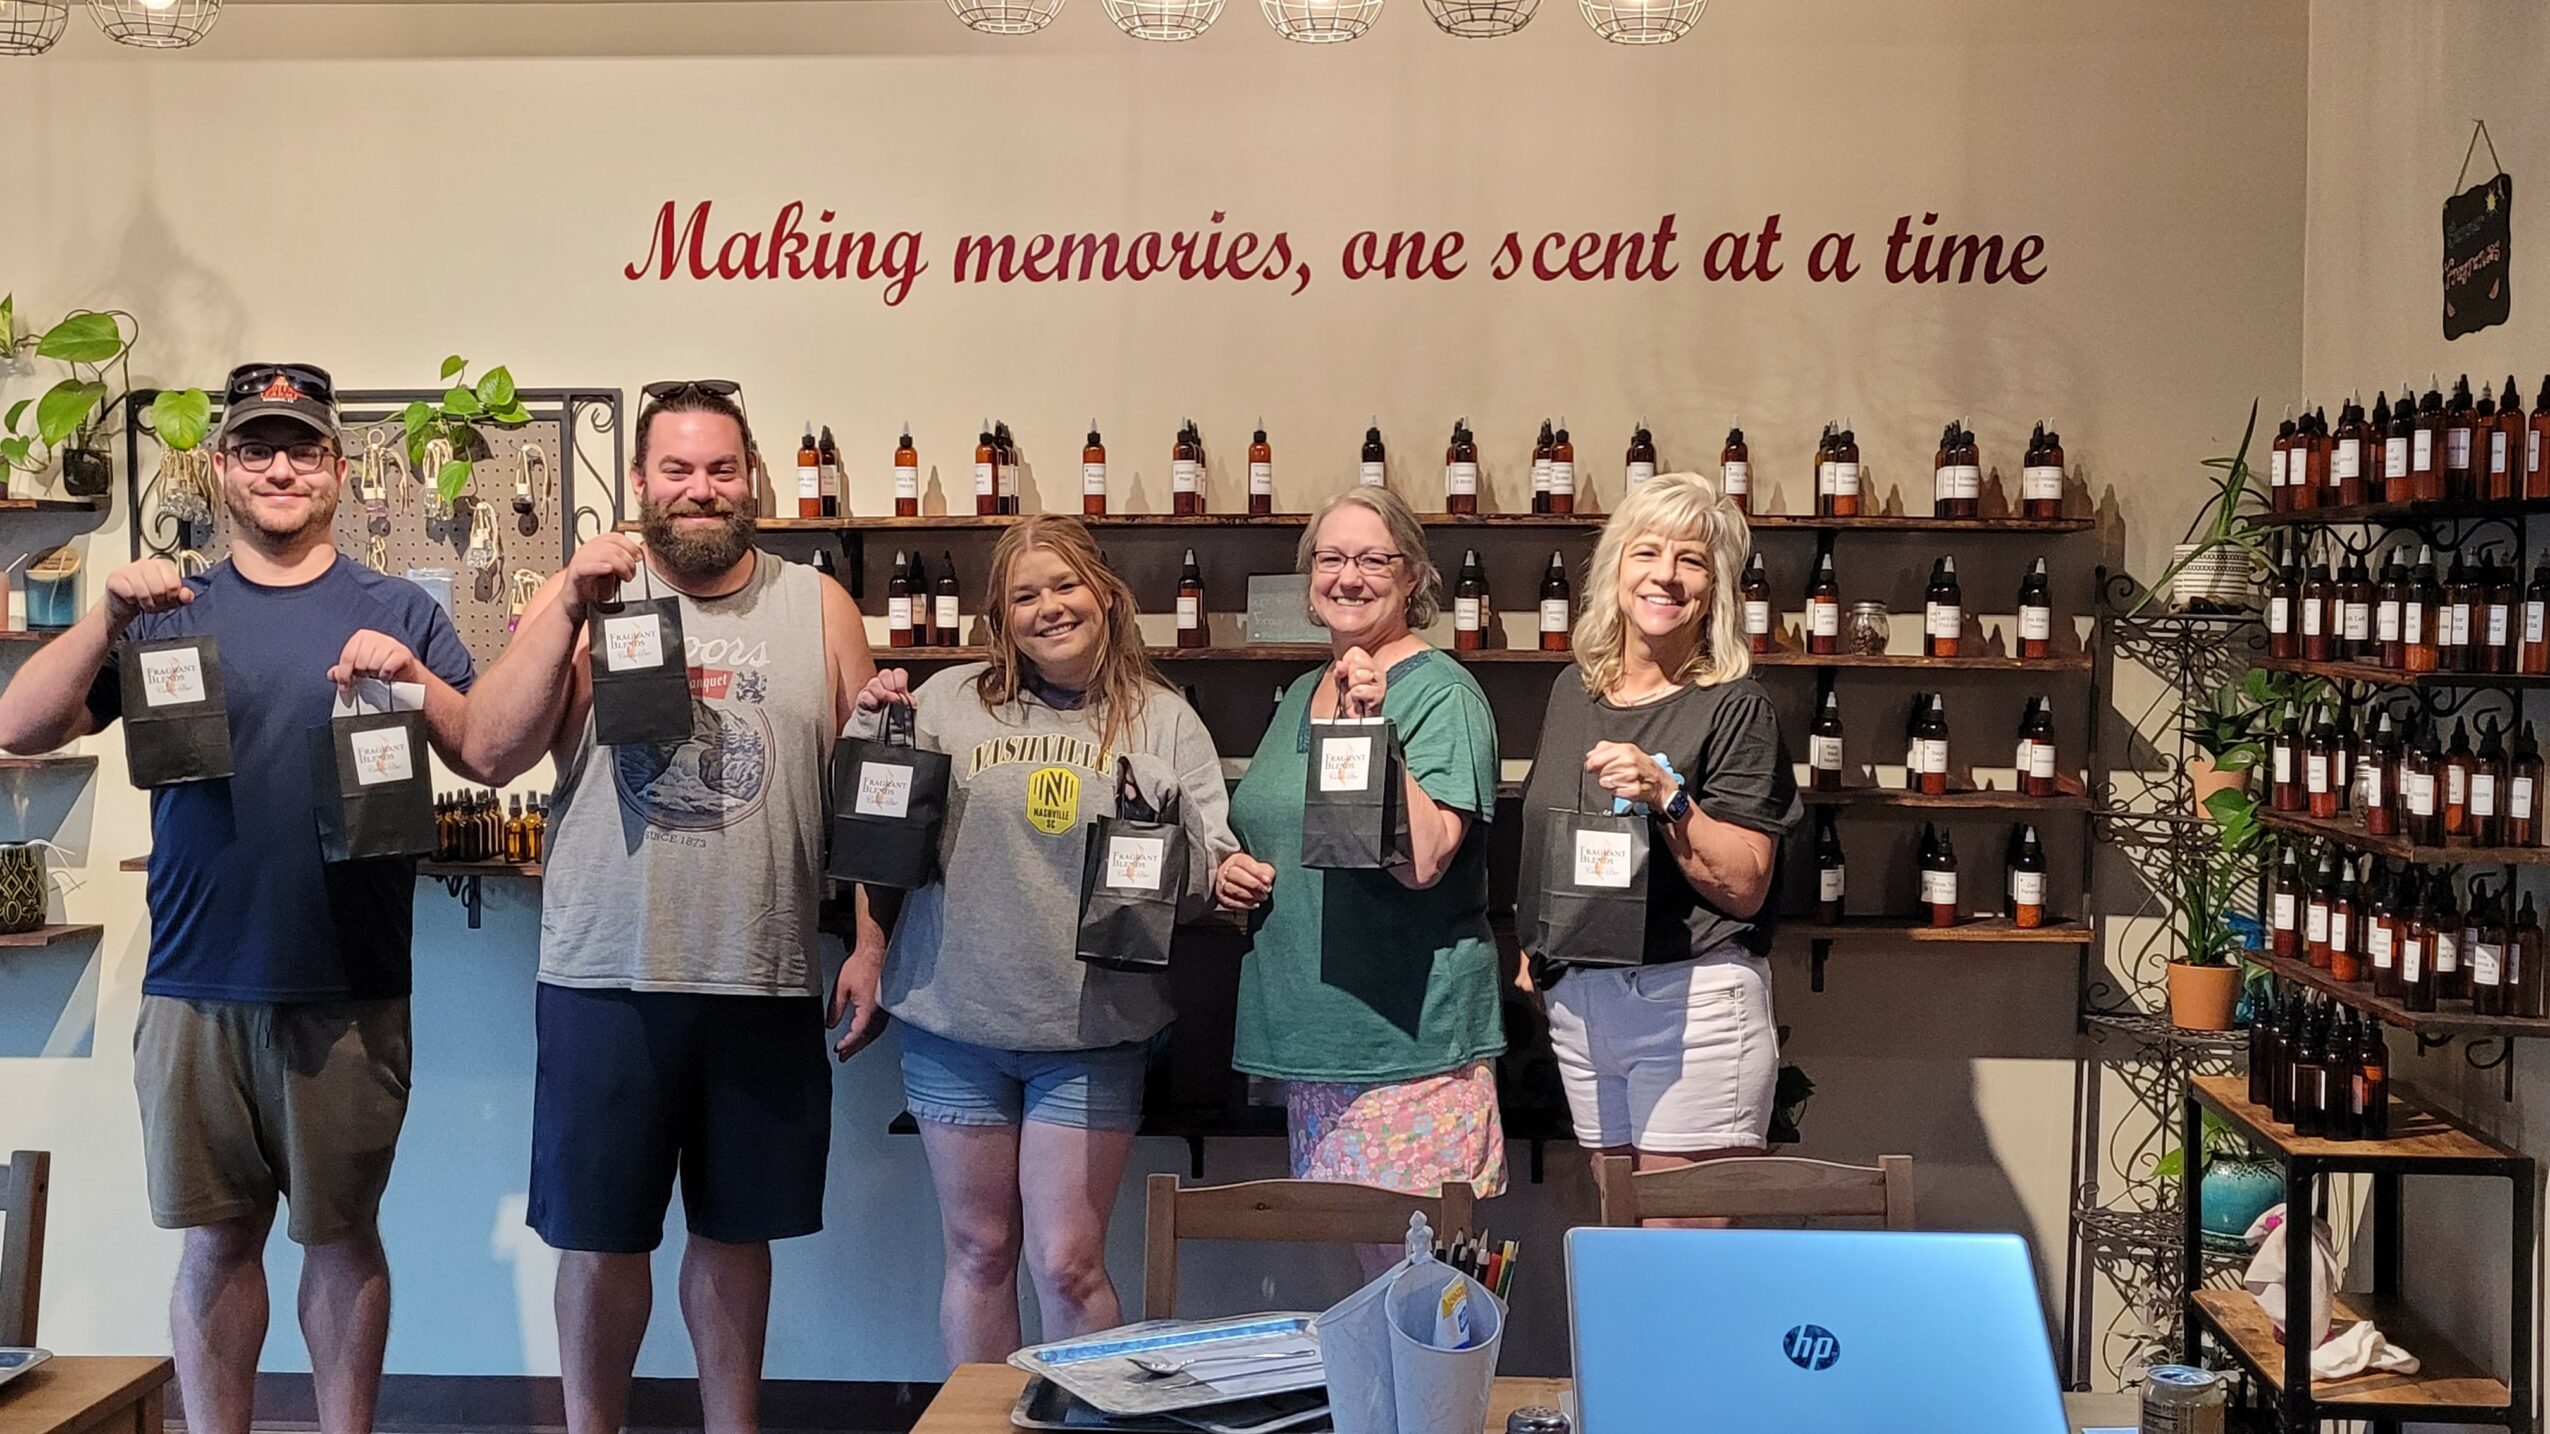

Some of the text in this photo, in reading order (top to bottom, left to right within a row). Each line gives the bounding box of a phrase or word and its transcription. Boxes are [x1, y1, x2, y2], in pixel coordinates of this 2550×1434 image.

[624, 200, 2044, 307] Making memories, one scent at a time
[684, 636, 771, 668] oors
[689, 672, 727, 694] anquet
[1033, 807, 1070, 821] NASHVILLE
[680, 836, 707, 848] 1873
[1791, 1324, 1834, 1371] hp
